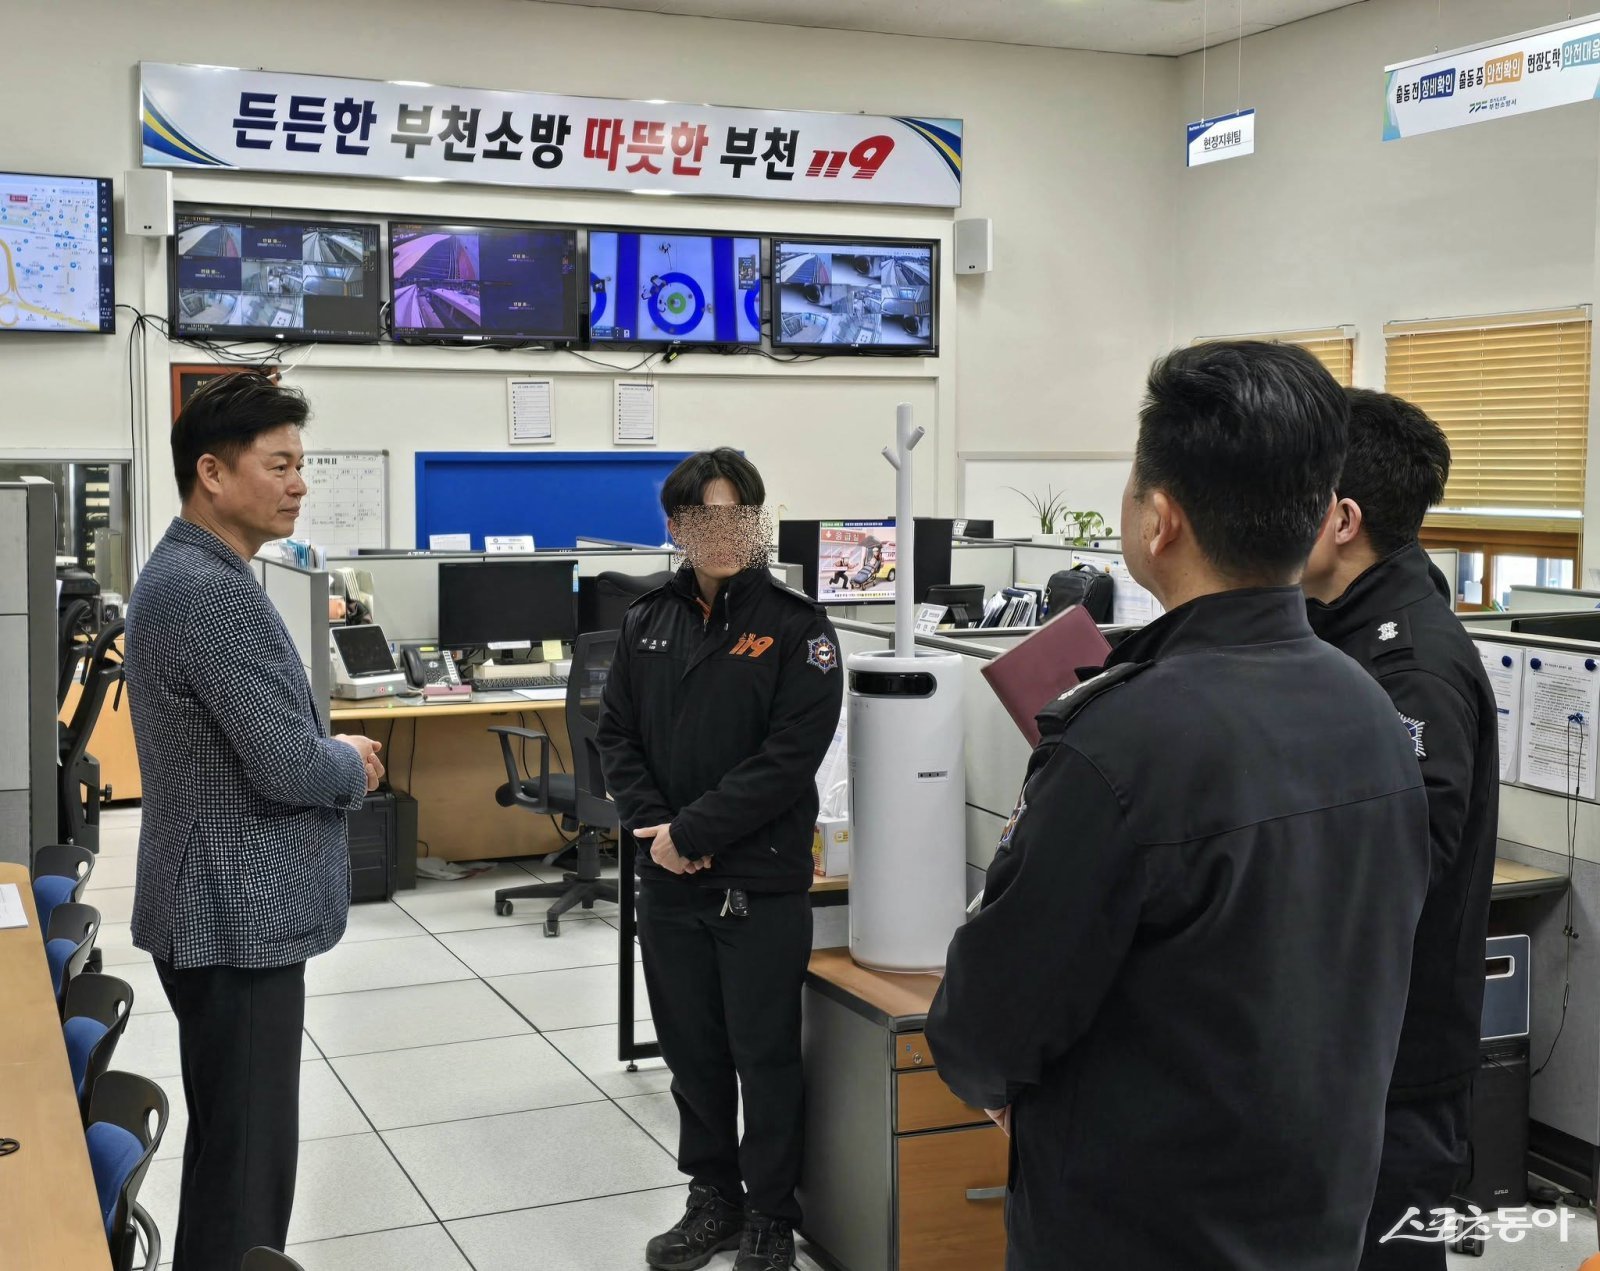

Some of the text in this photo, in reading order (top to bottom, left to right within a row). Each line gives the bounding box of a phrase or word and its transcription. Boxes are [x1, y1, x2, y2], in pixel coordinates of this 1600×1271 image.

[1396, 38, 1600, 104] 출동 전 장비확인 출동 중 안전확인 현장도착 안전대응
[232, 91, 895, 182] 든든한 부천소방 따뜻한 부천 119
[1203, 129, 1242, 150] 현장지휘팀
[729, 634, 774, 658] 119
